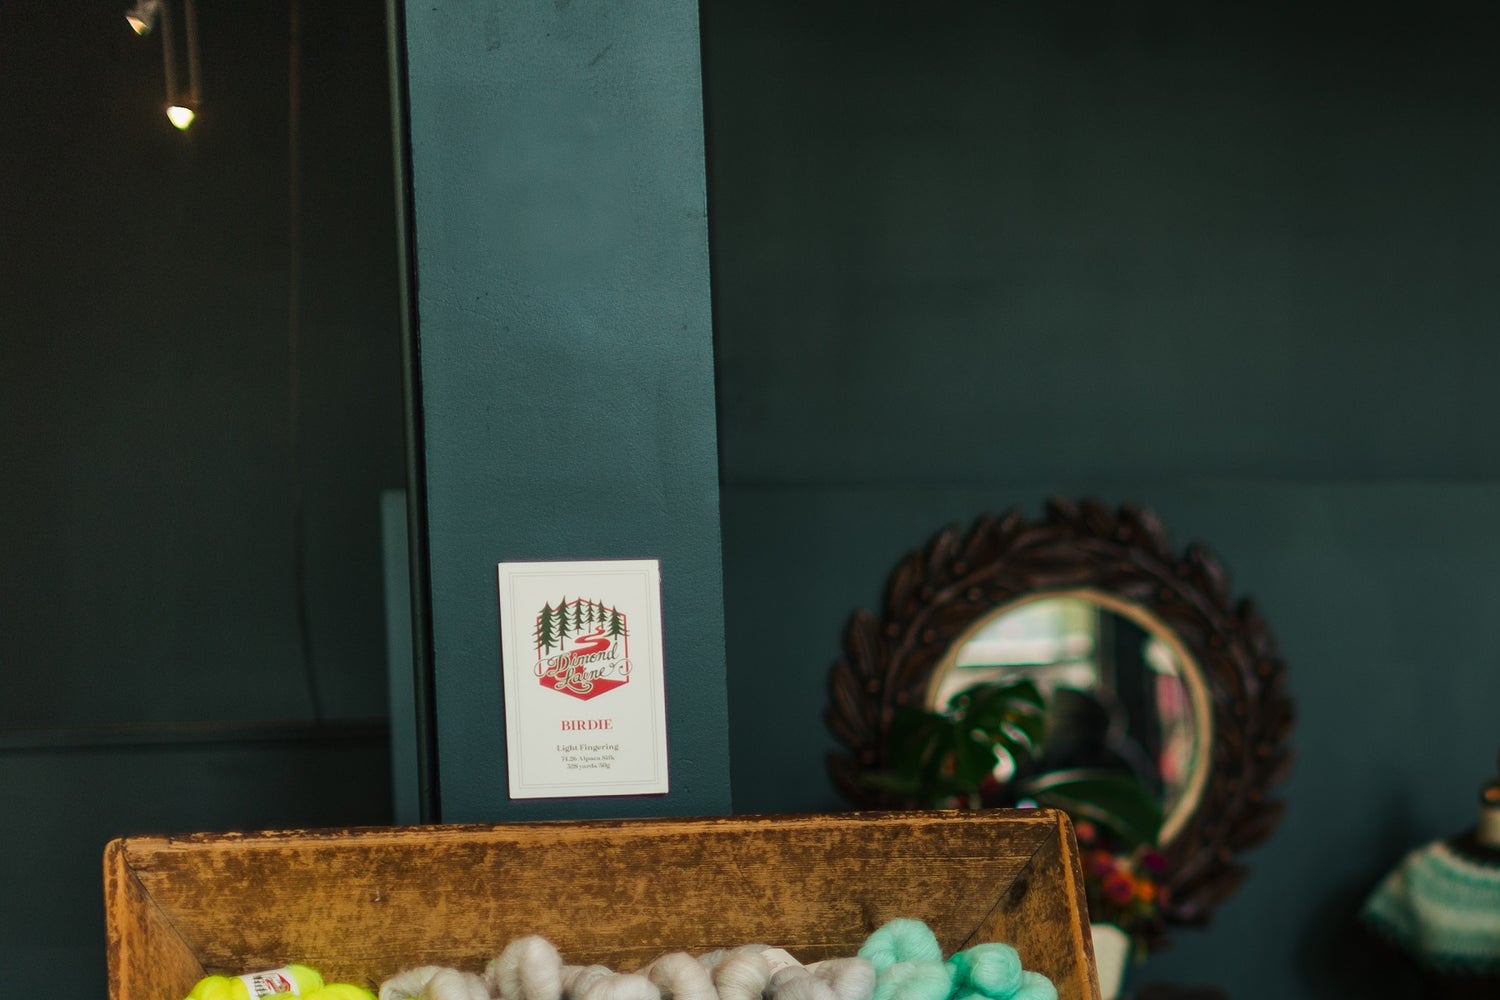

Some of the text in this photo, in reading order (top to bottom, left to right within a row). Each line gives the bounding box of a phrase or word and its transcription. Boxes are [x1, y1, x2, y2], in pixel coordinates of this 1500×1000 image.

[554, 664, 612, 693] Laine
[561, 719, 613, 731] BIRDIE
[579, 743, 620, 752] Fingering
